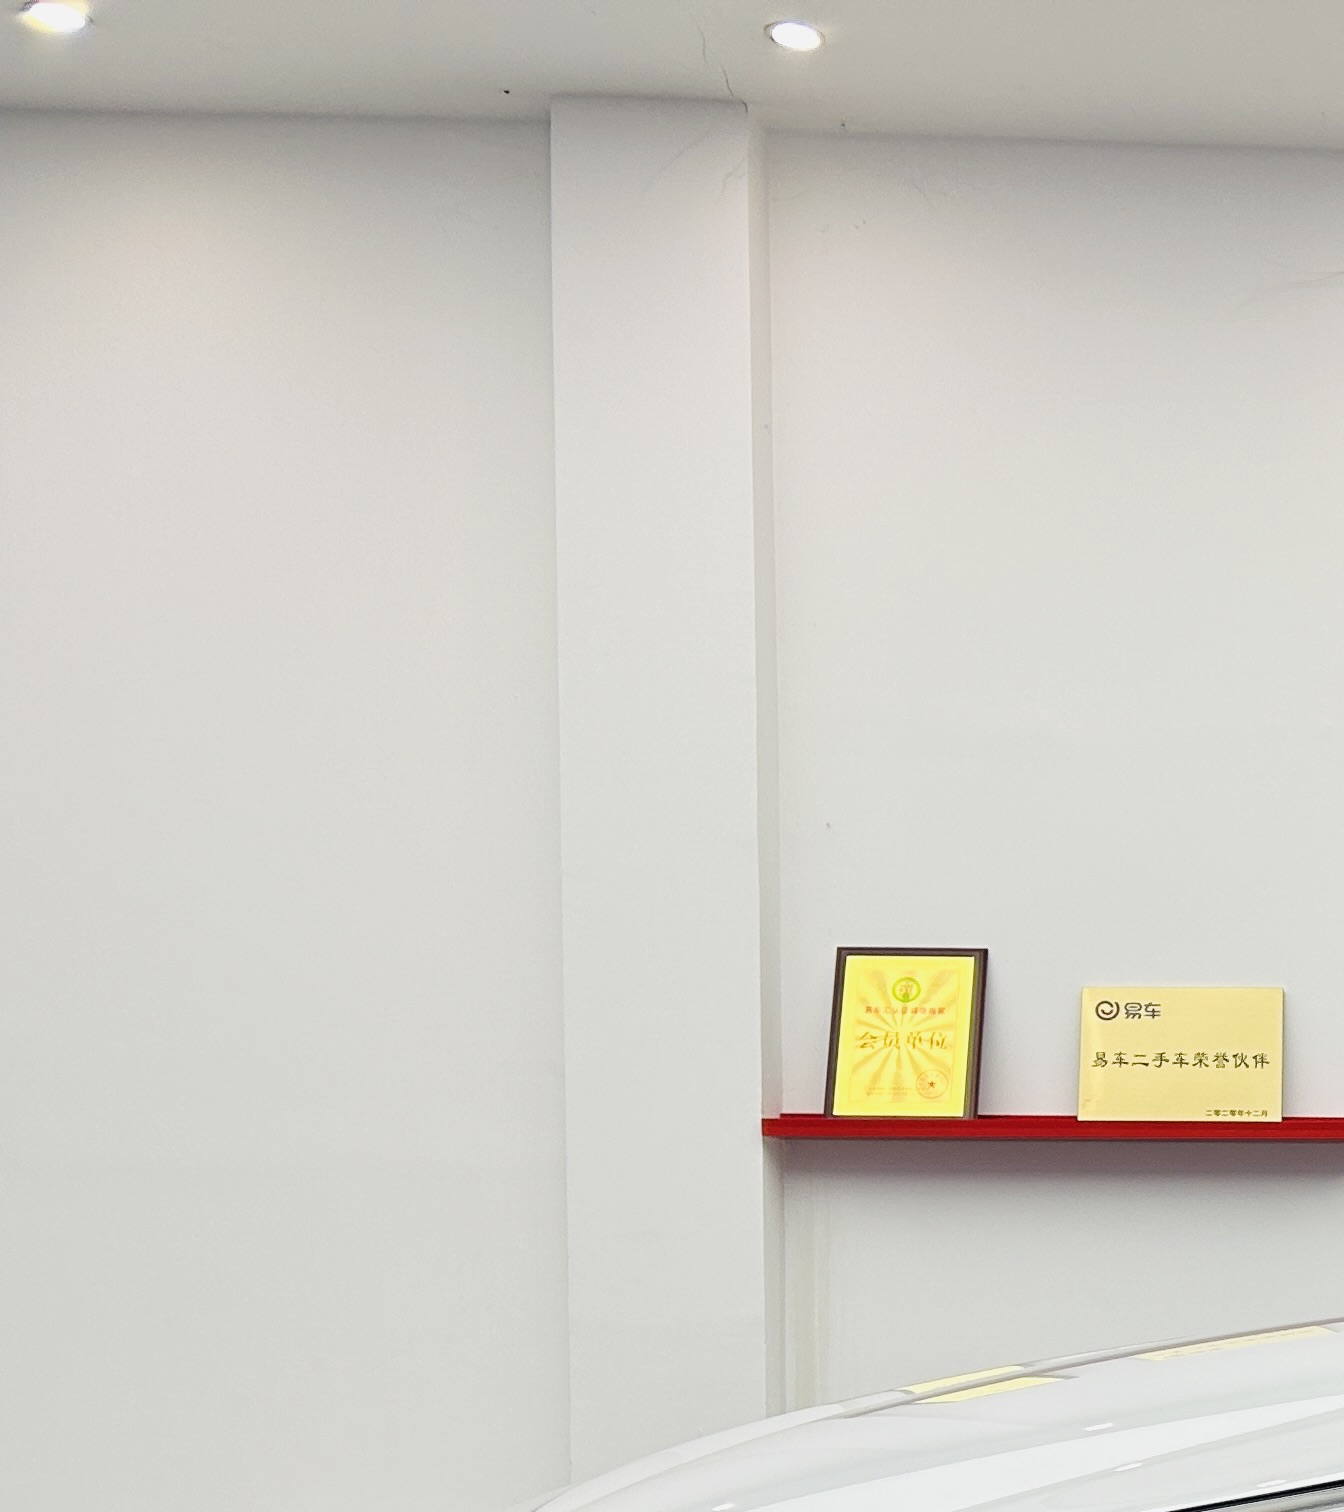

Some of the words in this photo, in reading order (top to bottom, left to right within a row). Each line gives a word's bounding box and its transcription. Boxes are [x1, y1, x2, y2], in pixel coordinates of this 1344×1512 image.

[1124, 1001, 1162, 1020] 易车
[859, 1032, 947, 1050] 会员单位
[1091, 1051, 1270, 1069] 易车二手车荣誉伙伴
